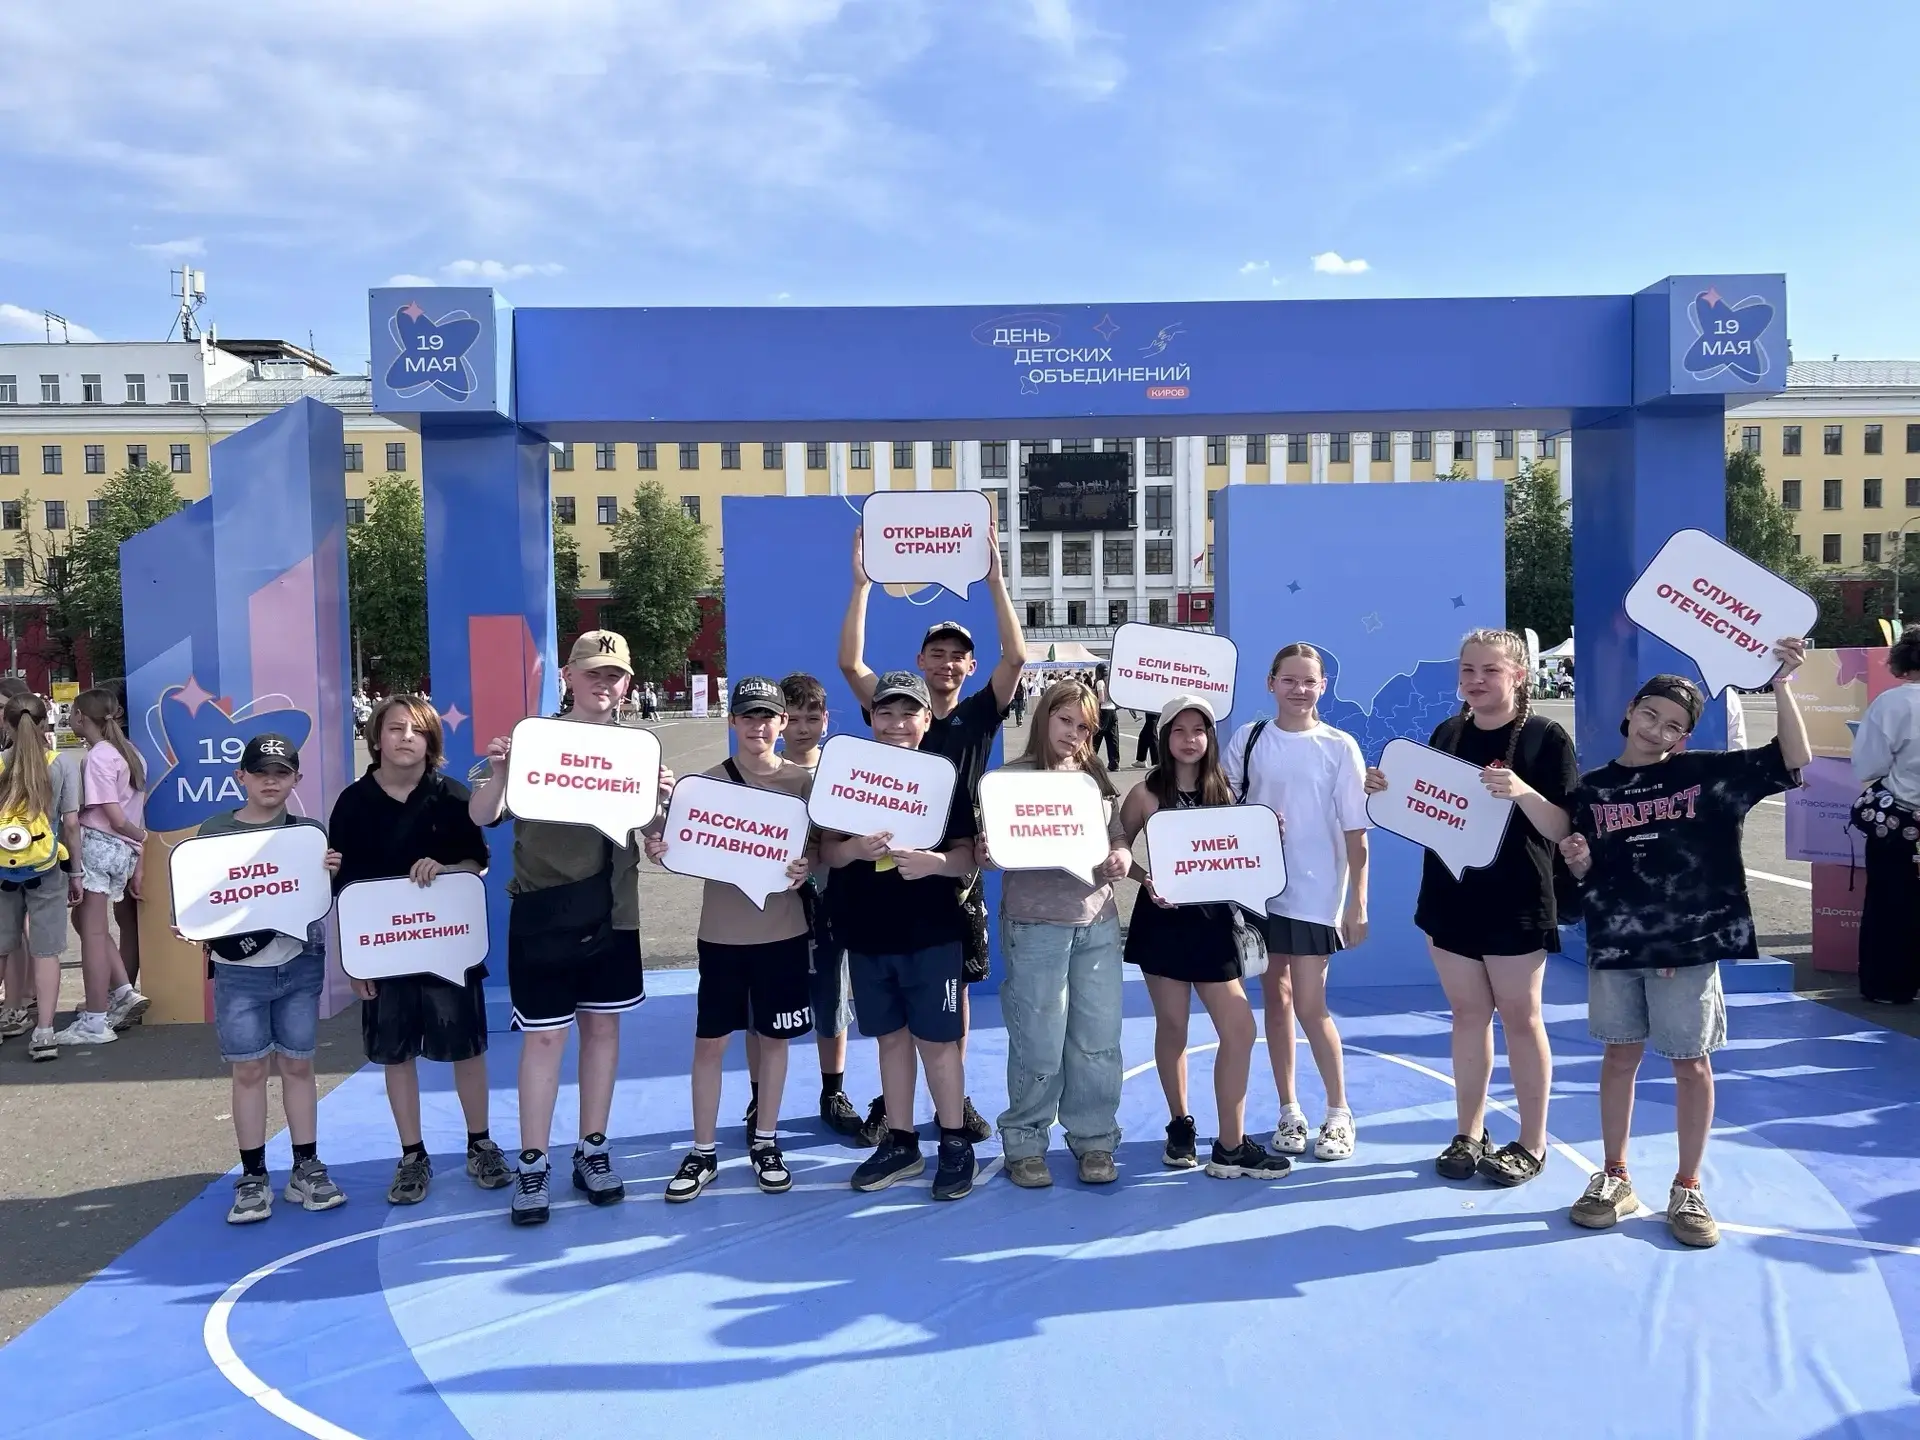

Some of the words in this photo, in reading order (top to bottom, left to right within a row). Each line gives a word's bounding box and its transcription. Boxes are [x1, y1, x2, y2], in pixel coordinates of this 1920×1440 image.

[992, 328, 1051, 345] ДЕНЬ
[1713, 319, 1740, 335] 19
[416, 334, 444, 351] 19
[1702, 340, 1751, 356] МАЯ
[404, 356, 457, 373] МАЯ
[1013, 347, 1113, 365] ДЕТСКИХ
[1028, 362, 1191, 385] ОБЪЕДИНЕНИЙ
[1150, 388, 1185, 398] КИРОВ
[883, 523, 972, 539] ОТКРЫВАЙ
[894, 541, 961, 554] СТРАНУ!
[1692, 577, 1762, 626] СЛУЖИ
[1656, 583, 1769, 659] ОТЕЧЕСТВУ!
[1138, 657, 1171, 670] ЕСЛИ
[1173, 662, 1210, 678] БЫТЬ,
[739, 682, 778, 697] COLLEGE
[1117, 667, 1133, 678] ТО
[1135, 670, 1169, 684] БЫТЬ
[1171, 675, 1228, 693] ПЕРВЫМ!
[198, 737, 246, 764] 19
[560, 753, 613, 770] БЫТЬ
[177, 776, 249, 802] МА
[527, 771, 540, 785] С
[544, 772, 641, 794] РОССИЕЙ!
[850, 768, 904, 791] УЧИСЬ
[906, 782, 919, 795] И
[831, 784, 928, 816] ПОЗНАВАЙ!
[1414, 779, 1469, 810] БЛАГО
[1015, 804, 1074, 816] БЕРЕГИ
[1406, 795, 1466, 831] ТВОРИ!
[1589, 784, 1701, 839] PERFECT
[688, 808, 789, 840] РАССКАЖИ
[1010, 824, 1085, 837] ПЛАНЕТУ!
[680, 829, 693, 842] О
[696, 831, 788, 862] ГЛАВНОМ!
[1191, 835, 1239, 852] УМЕЙ
[228, 863, 279, 880] БУДЬ
[1174, 856, 1261, 875] ДРУЖИТЬ!
[209, 879, 299, 905] ЗДОРОВ!
[392, 912, 436, 926] БЫТЬ
[1815, 907, 1862, 917] «Дости
[359, 935, 370, 946] В
[373, 924, 470, 946] ДВИЖЕНИИ!
[773, 1006, 809, 1030] JUST
